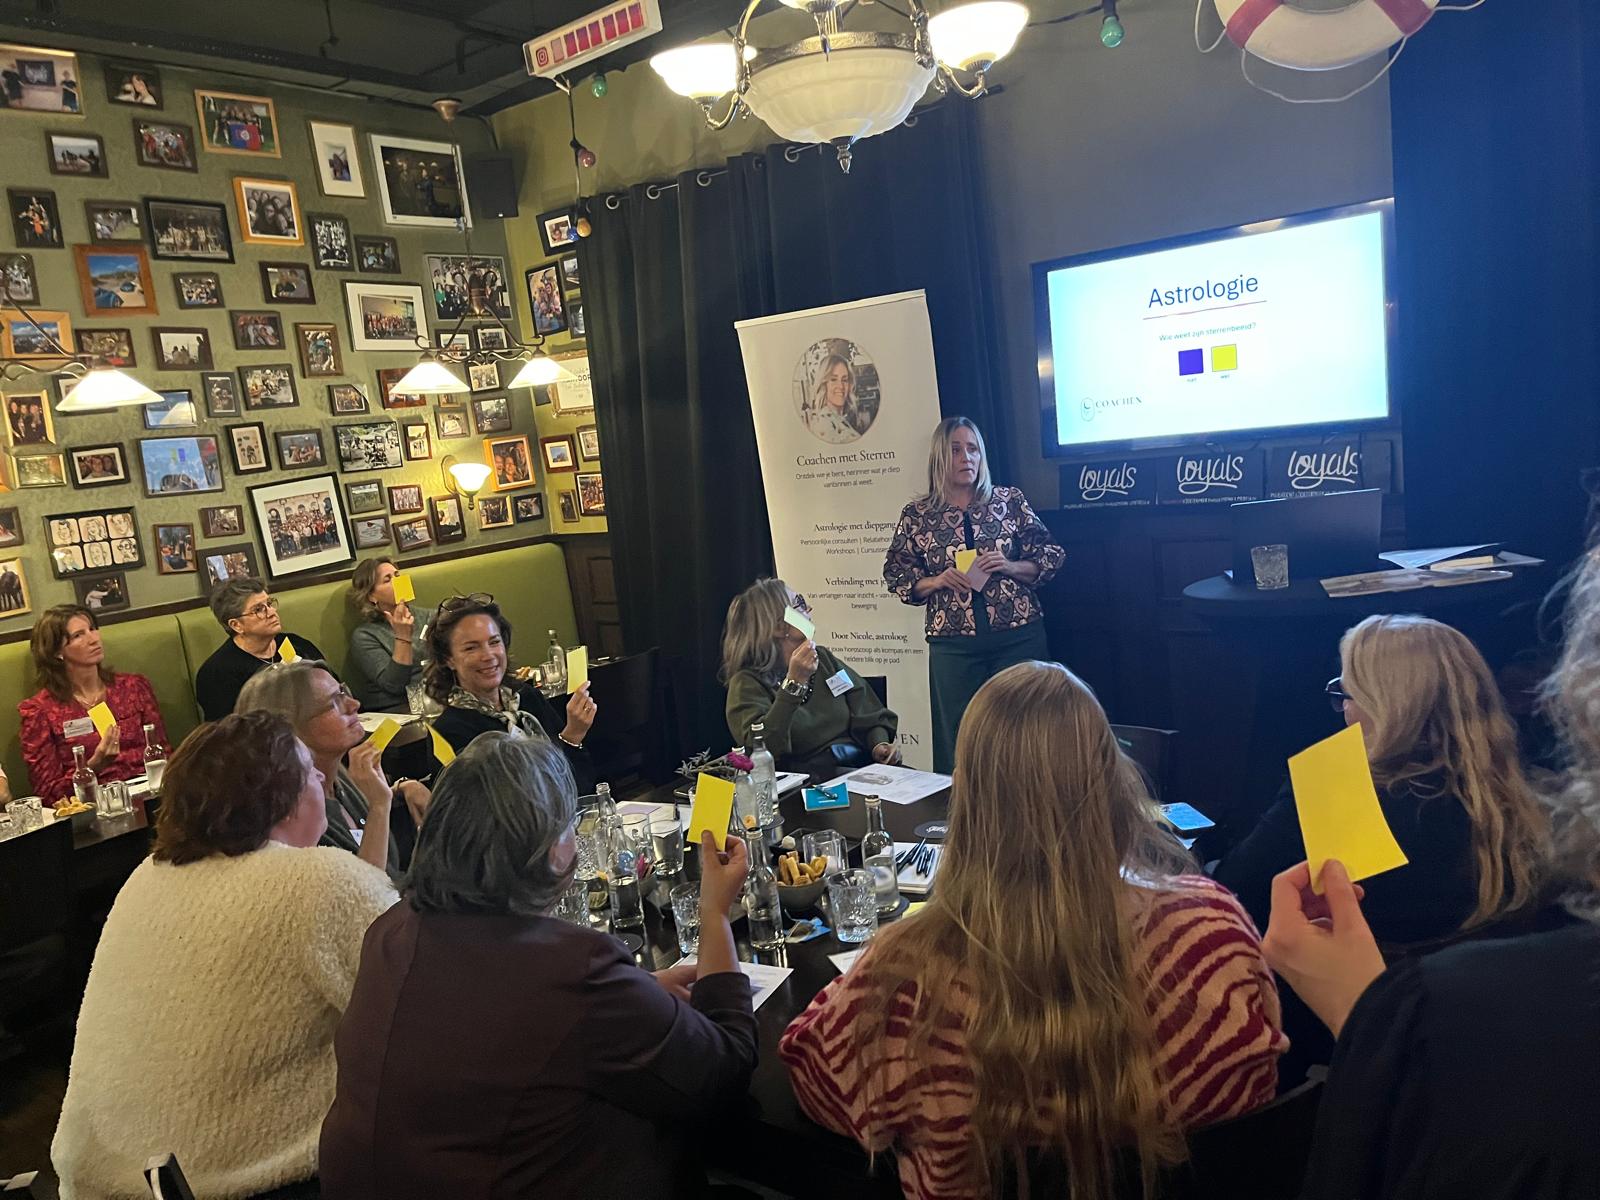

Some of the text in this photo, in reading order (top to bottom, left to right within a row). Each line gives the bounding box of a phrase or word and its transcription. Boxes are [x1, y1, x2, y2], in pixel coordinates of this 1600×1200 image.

[1148, 274, 1258, 308] Astrologie
[796, 450, 895, 466] Coachen met Sterren
[815, 522, 848, 533] Astrologie
[865, 521, 896, 532] diepgang
[826, 577, 864, 588] Verbinding
[850, 632, 874, 640] Nicole,
[875, 632, 908, 643] astroloog
[901, 734, 919, 745] EN
